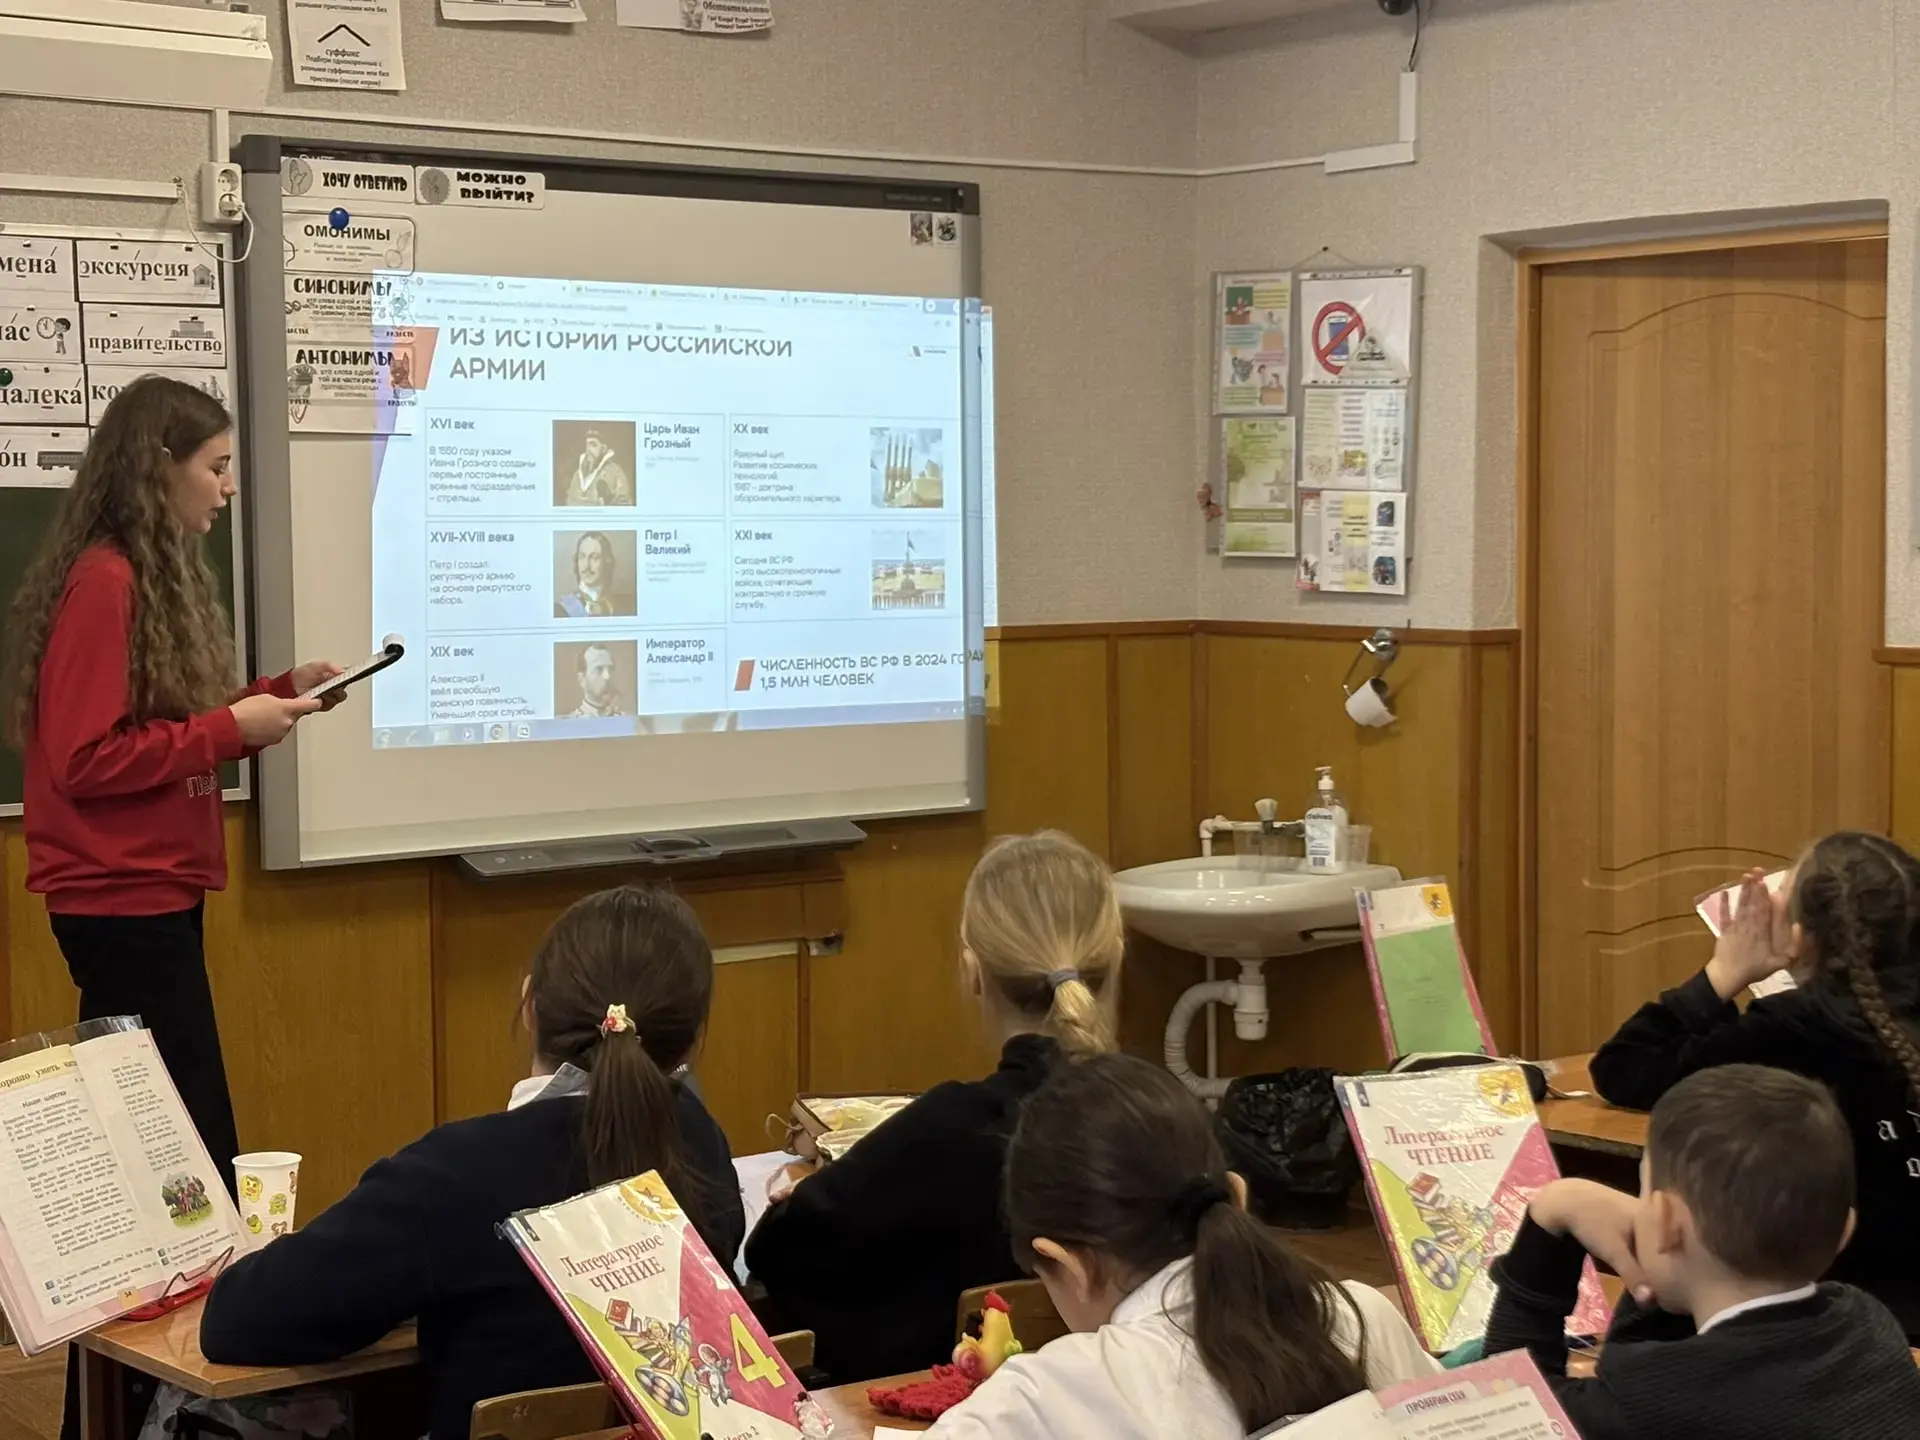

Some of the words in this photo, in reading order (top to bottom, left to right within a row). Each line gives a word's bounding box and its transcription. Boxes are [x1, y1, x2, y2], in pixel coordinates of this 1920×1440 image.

[325, 48, 360, 58] суффикс
[323, 172, 351, 188] ХОЧУ
[354, 174, 408, 191] ОТВЕТИТЬ
[456, 171, 526, 185] МОЖНО
[303, 224, 390, 241] ОМОНИМЫ
[294, 278, 392, 296] СИНОНИМЫ
[450, 328, 485, 346] ИЗ
[495, 330, 618, 350] ИСТОРИИ
[296, 349, 394, 366] АНТОНИМЫ
[450, 357, 546, 381] АРМИИ
[454, 420, 475, 430] век
[644, 423, 671, 436] Царь
[673, 424, 700, 435] Иван
[751, 424, 769, 434] век
[644, 436, 691, 451] Грозный
[459, 448, 480, 458] году
[482, 448, 512, 458] указом
[457, 459, 498, 470] Грозного
[488, 533, 515, 543] века
[645, 530, 672, 543] Петр
[754, 531, 773, 541] век
[645, 543, 691, 556] Великий
[441, 584, 474, 593] основе
[476, 583, 532, 595] рекрутского
[453, 646, 475, 657] век
[645, 638, 706, 652] Император
[646, 651, 706, 665] Александр
[761, 656, 857, 672] ЧИСЛЕННОСТЬ
[860, 655, 877, 668] ВС
[881, 655, 899, 668] РФ
[903, 655, 912, 666] В
[915, 653, 947, 666] 2024
[430, 674, 478, 686] Александр
[761, 676, 777, 691] 1,5
[780, 675, 809, 688] МЛН
[813, 673, 875, 687] ЧЕЛОВЕК
[452, 684, 500, 697] всеобщую
[477, 707, 499, 719] срок
[35, 1064, 60, 1078] уметь
[1405, 1143, 1496, 1166] ЧТЕНИЕ
[559, 1232, 664, 1278] Литературное
[589, 1256, 665, 1294] ЧТЕНИЕ
[728, 1312, 787, 1389] 4
